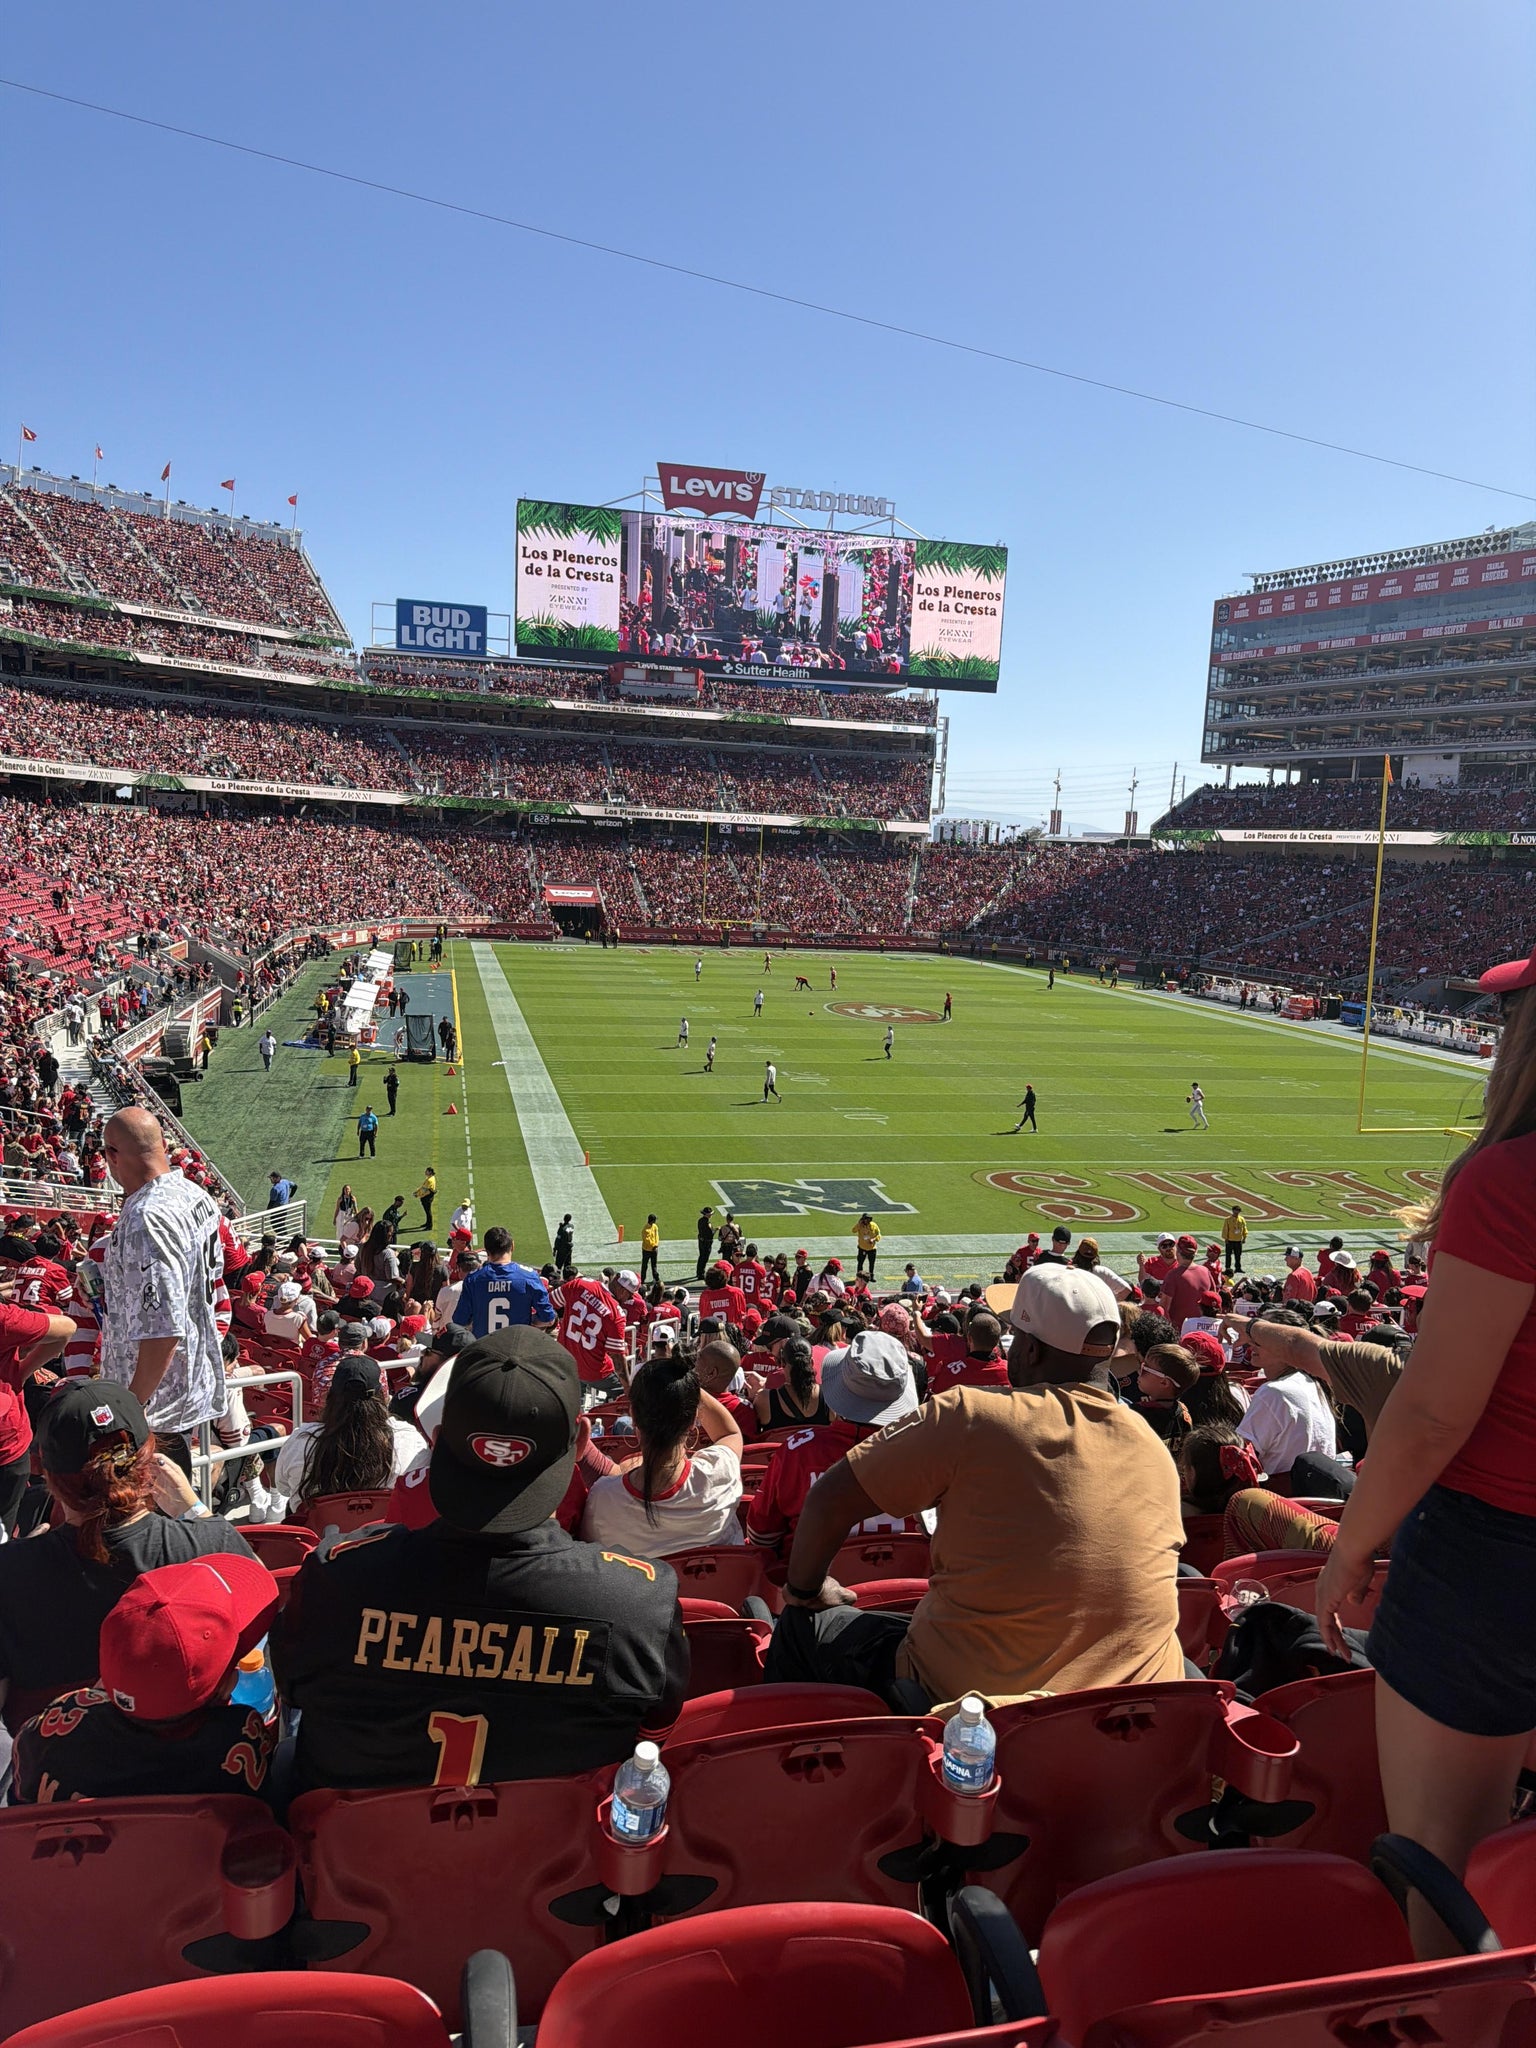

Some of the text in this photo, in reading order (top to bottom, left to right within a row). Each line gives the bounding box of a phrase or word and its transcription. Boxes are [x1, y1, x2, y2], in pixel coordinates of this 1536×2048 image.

[771, 486, 887, 517] STADIUM
[522, 546, 618, 566] Los Pleneros
[525, 563, 614, 583] de la Cresta
[551, 584, 580, 592] PRESENTED
[917, 584, 1002, 601] Los Pleneros
[549, 594, 588, 606] ZENNI
[919, 600, 997, 616] de la Cresta
[198, 616, 217, 626] Cresta
[413, 605, 471, 629] BUD
[401, 625, 482, 651] LIGHT
[939, 628, 974, 638] ZENNI
[218, 665, 238, 674] Cresta
[659, 664, 683, 672] STADIUM
[734, 663, 810, 678] Sutter Health
[28, 763, 36, 772] de
[38, 764, 44, 773] la
[45, 765, 65, 775] Cresta
[88, 770, 112, 780] ZENNI
[212, 781, 226, 790] Los
[228, 782, 263, 793] Pleneros
[264, 785, 274, 794] de
[276, 786, 284, 794] la
[286, 786, 311, 796] Cresta
[340, 791, 374, 800] ZENNI
[594, 819, 622, 828] verizon
[604, 808, 618, 816] Los
[622, 808, 652, 818] Pleneros
[654, 810, 664, 818] de
[666, 810, 673, 818] la
[674, 811, 699, 820] Cresta
[730, 815, 764, 823] ZENNI
[1244, 832, 1256, 840] Los
[1257, 832, 1288, 840] Pleneros
[1290, 832, 1298, 840] de
[1300, 832, 1306, 840] la
[1308, 832, 1332, 840] Cresta
[488, 1280, 512, 1293] DART
[738, 1276, 755, 1293] 19
[710, 1299, 730, 1308] YOUNG
[488, 1298, 510, 1334] 6
[566, 1301, 602, 1350] 23
[354, 1607, 594, 1686] PEARSALL
[427, 1711, 489, 1786] 1
